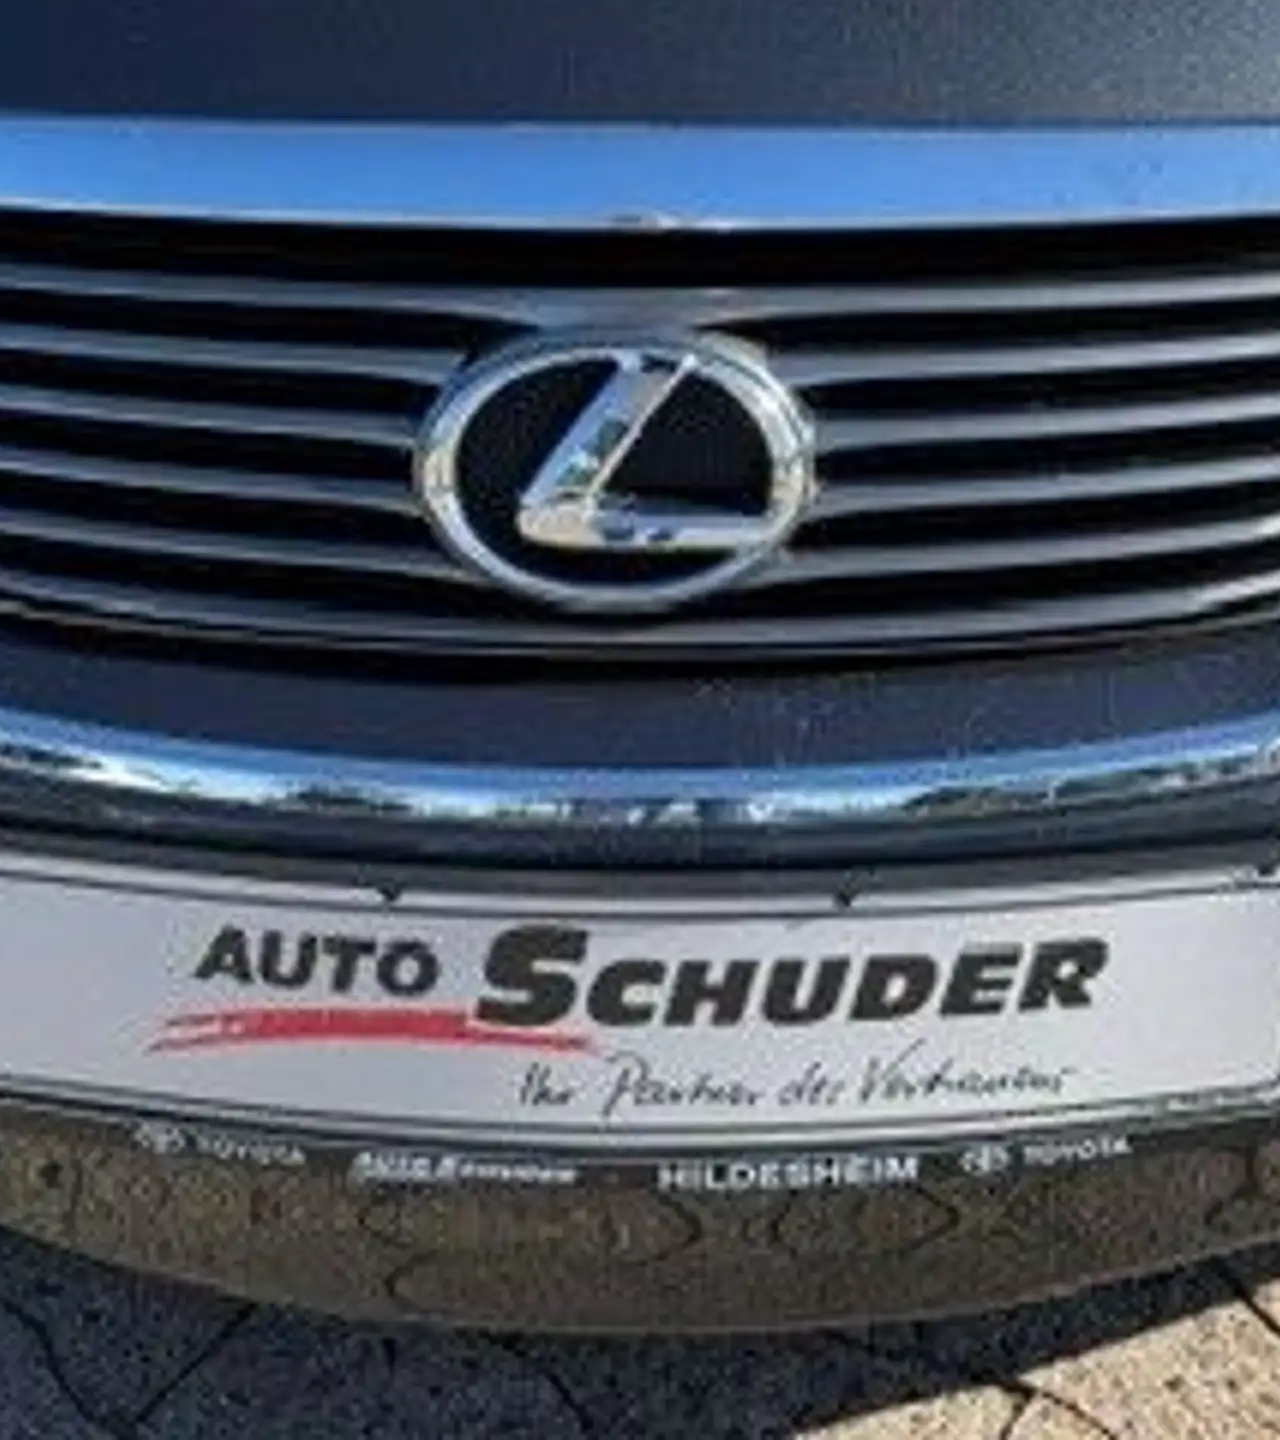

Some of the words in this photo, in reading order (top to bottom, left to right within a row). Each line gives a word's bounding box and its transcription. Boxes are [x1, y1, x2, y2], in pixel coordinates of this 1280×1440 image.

[194, 923, 441, 996] AUTO
[475, 923, 1108, 1027] SCHUDER
[1022, 1135, 1134, 1165] TOYOTA
[656, 1153, 920, 1191] HILDESHEIM
